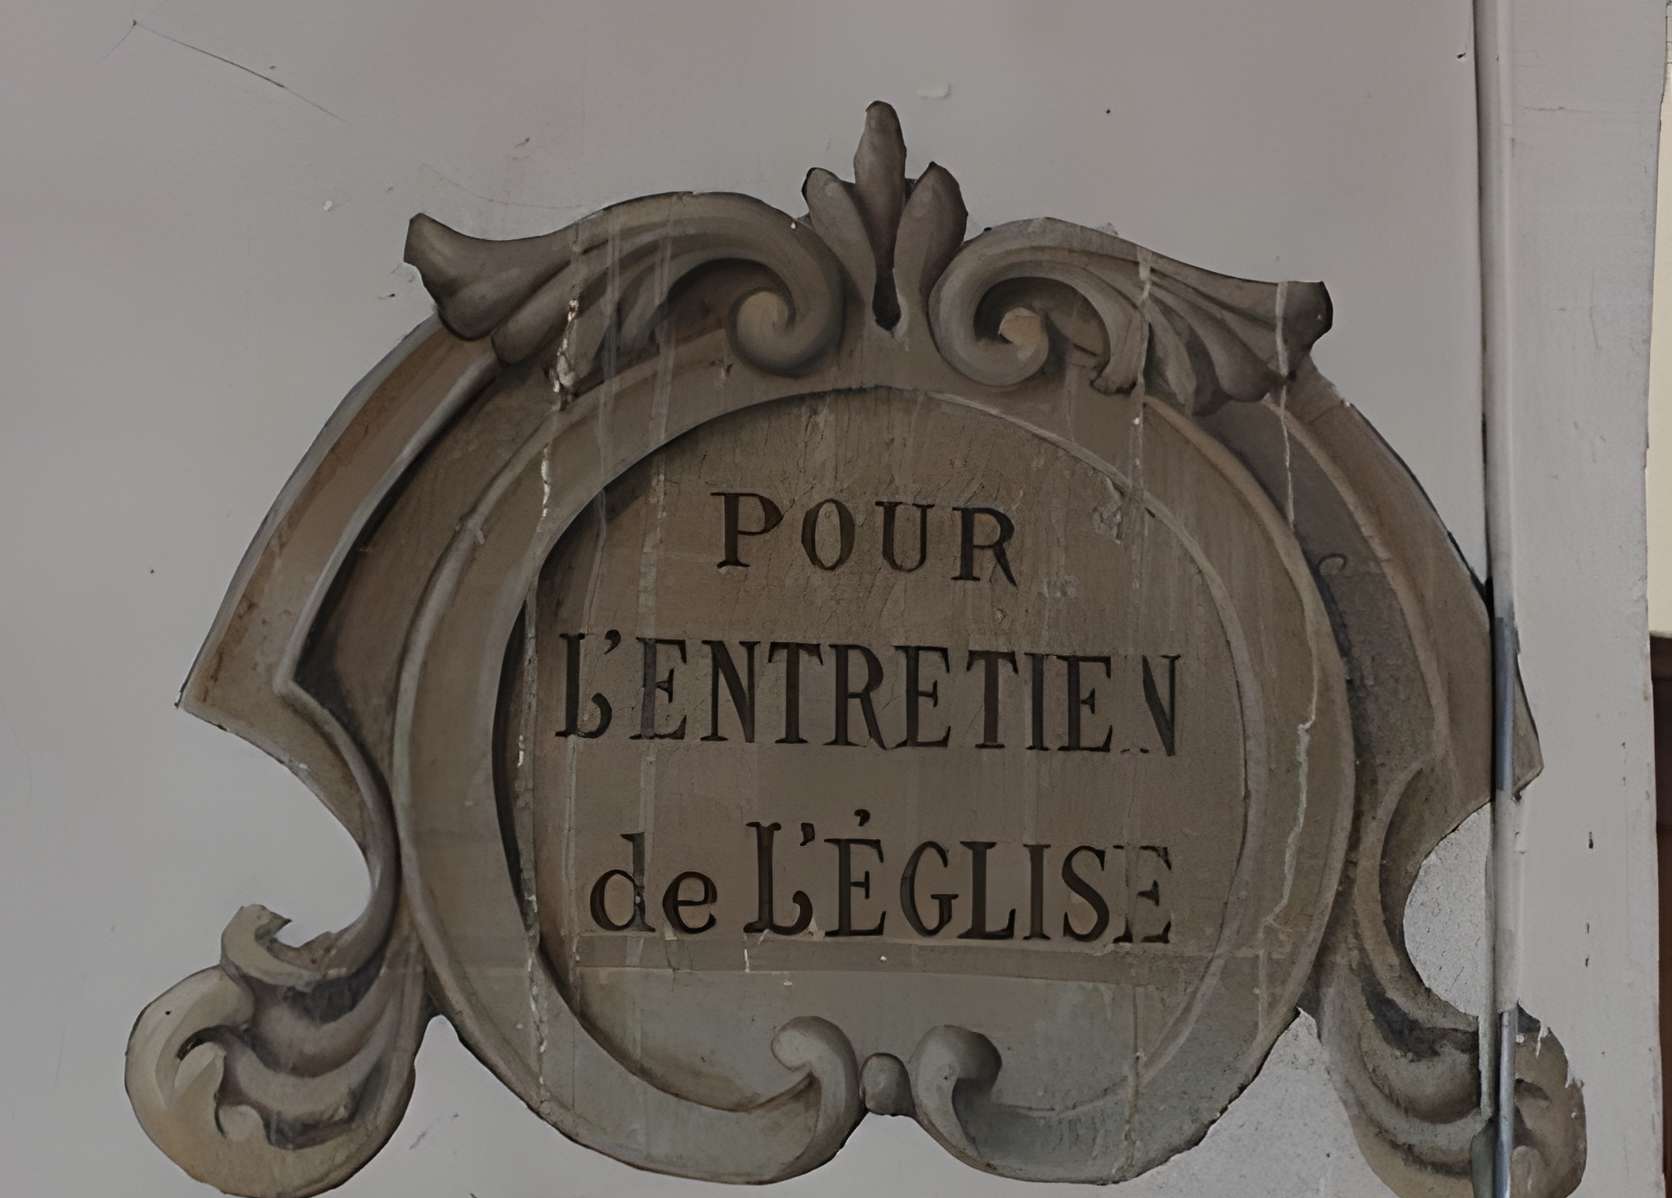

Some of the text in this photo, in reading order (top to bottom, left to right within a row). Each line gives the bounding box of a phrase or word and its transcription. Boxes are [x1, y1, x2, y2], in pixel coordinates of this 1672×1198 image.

[710, 491, 1018, 587] POUR
[555, 629, 1181, 756] L'ENTRETIEN
[590, 808, 1172, 944] de L'ÉGLISE
